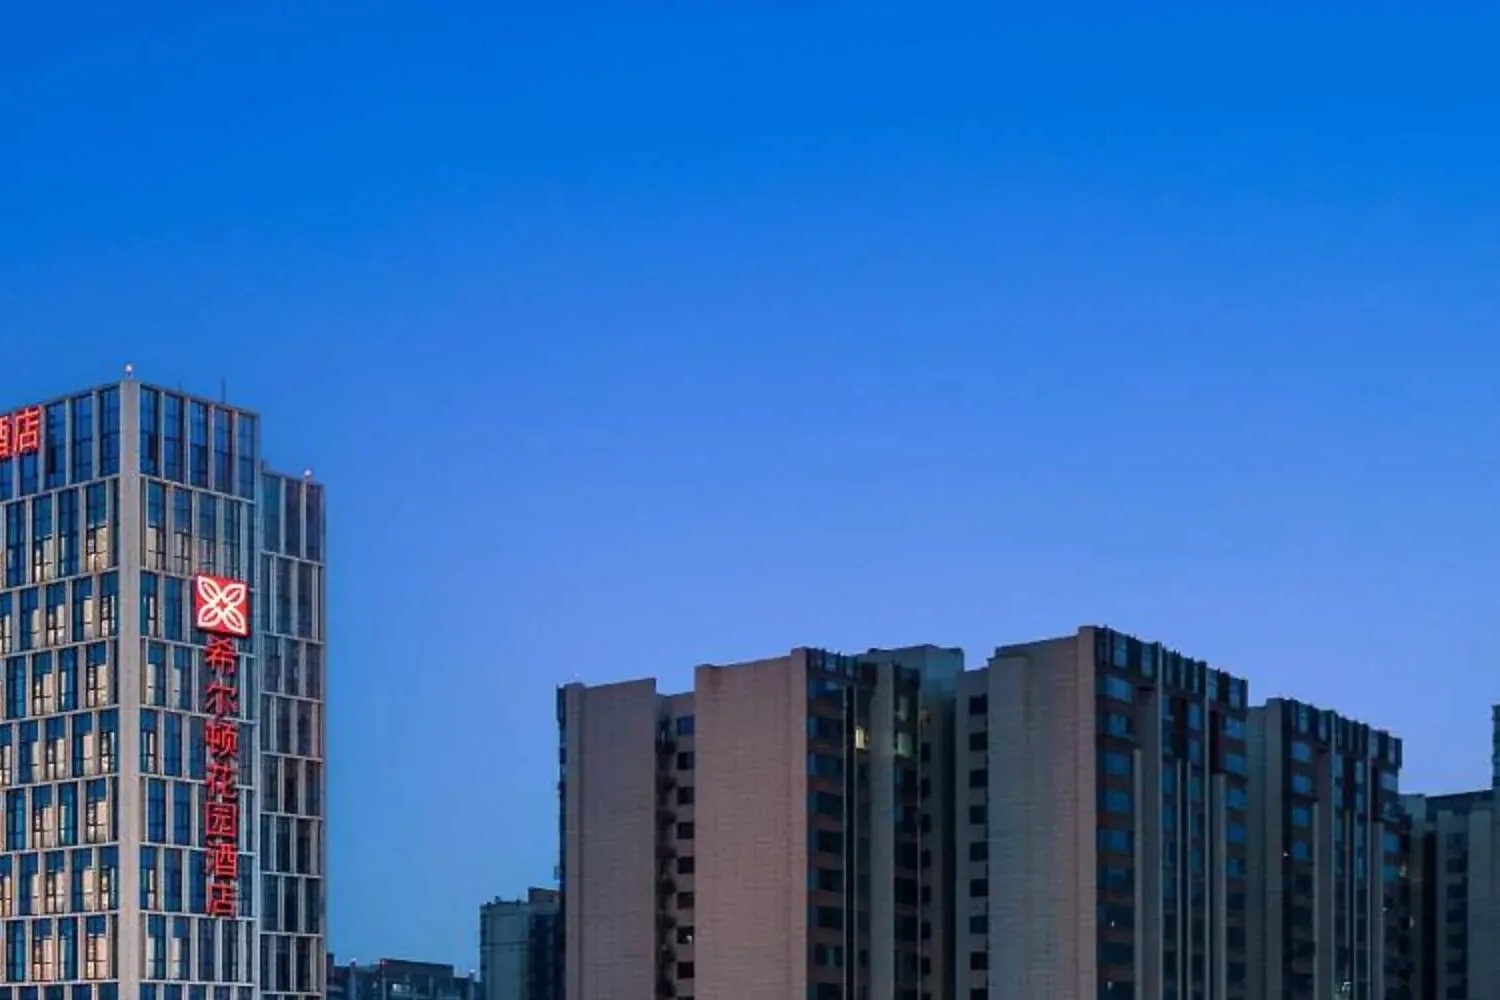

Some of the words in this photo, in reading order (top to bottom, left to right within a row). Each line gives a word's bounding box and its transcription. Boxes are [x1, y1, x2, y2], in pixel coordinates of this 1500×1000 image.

[204, 636, 238, 917] 希尔顿花园酒店
